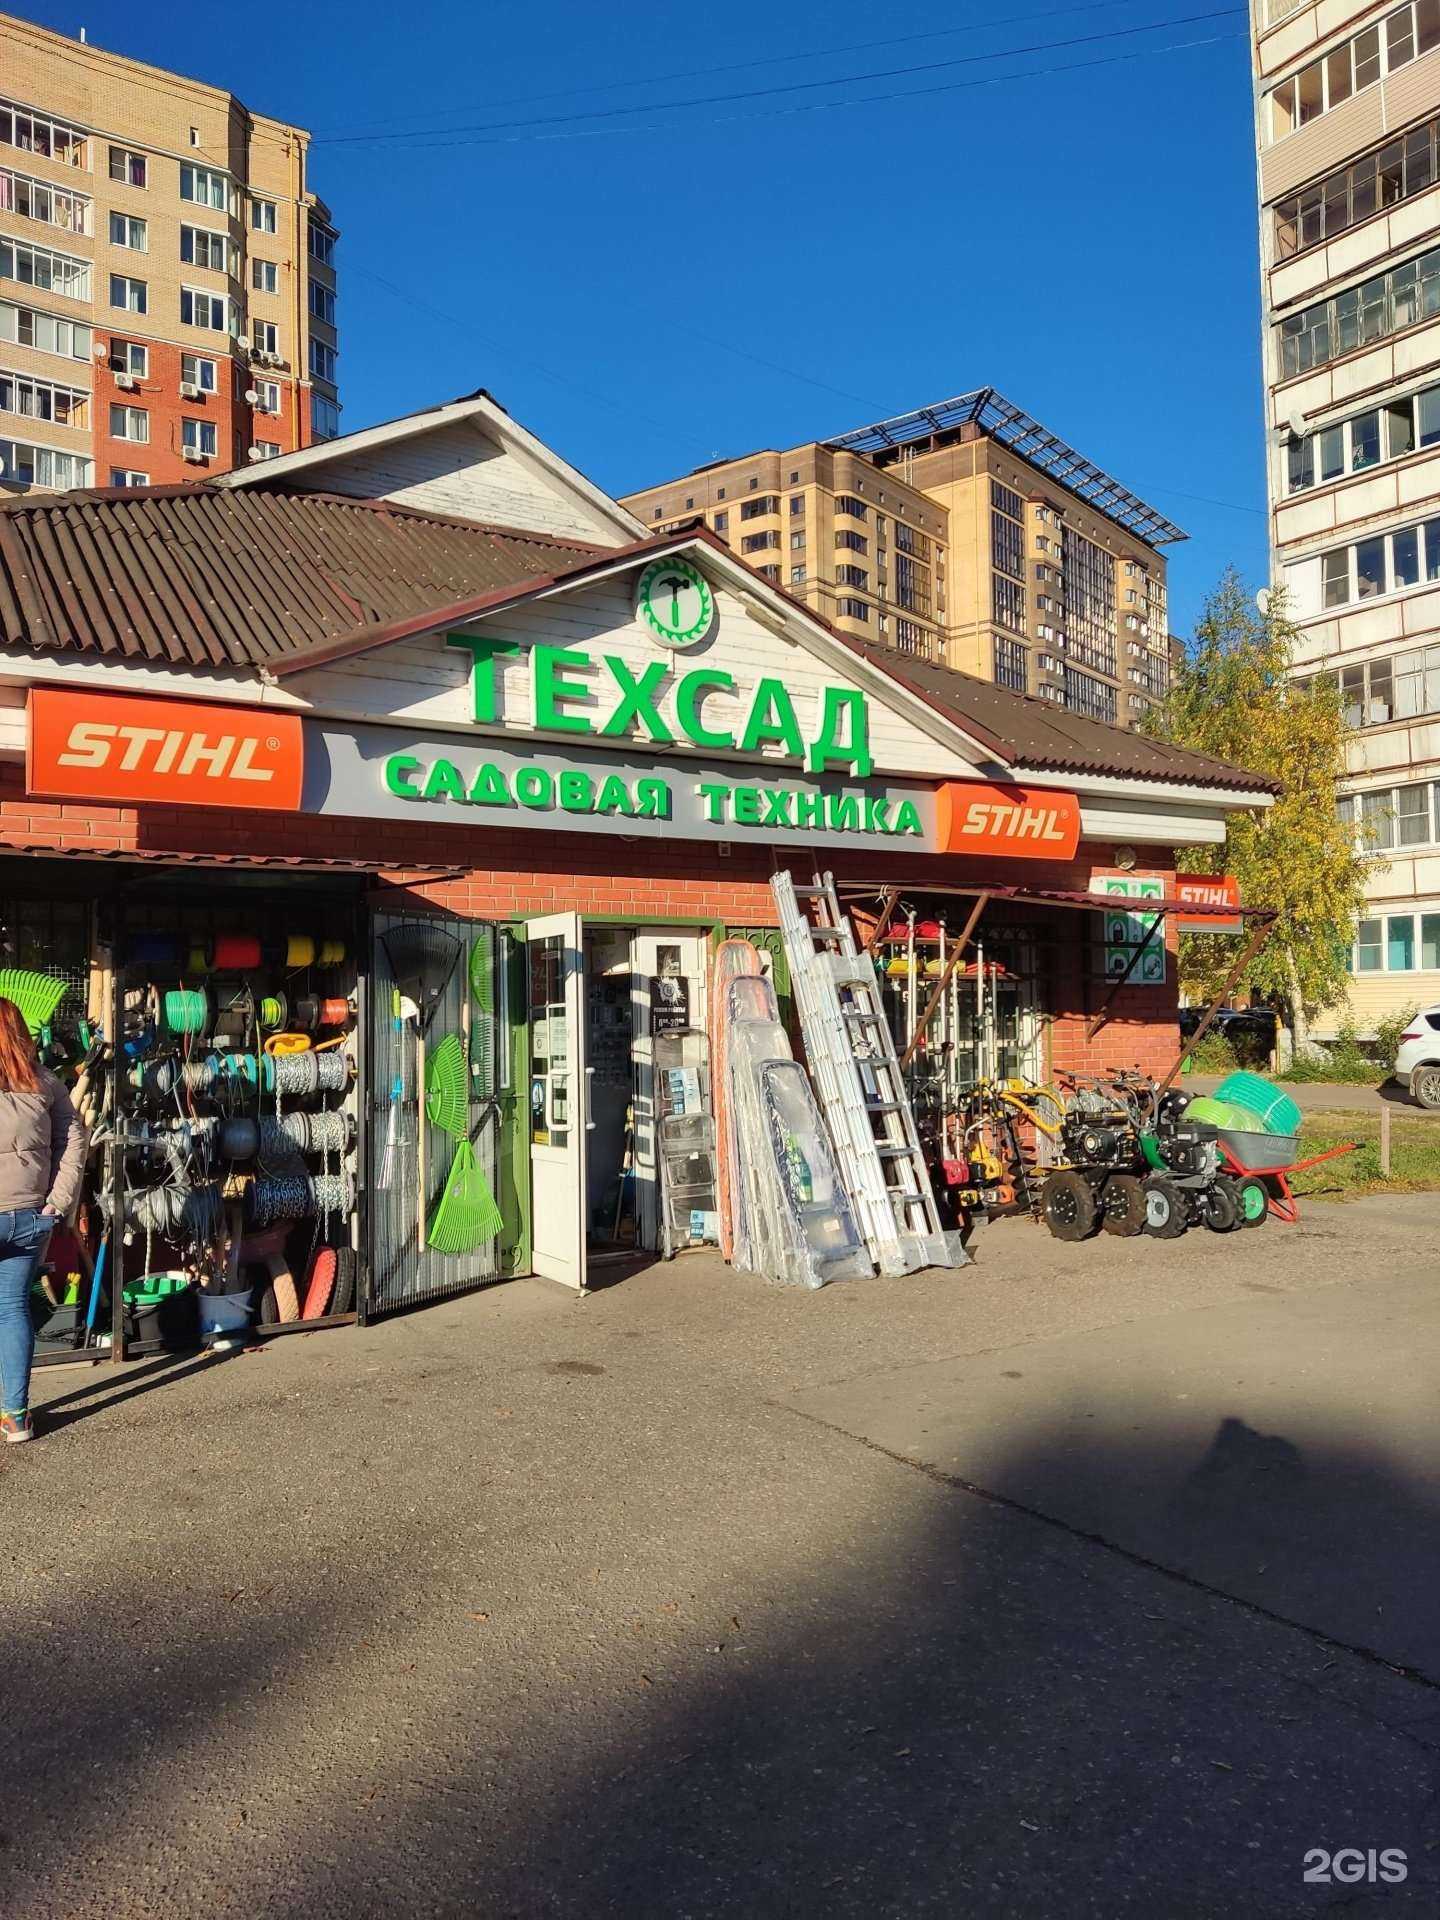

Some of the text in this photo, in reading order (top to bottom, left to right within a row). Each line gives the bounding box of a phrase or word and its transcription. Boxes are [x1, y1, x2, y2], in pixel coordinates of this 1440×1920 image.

[447, 633, 874, 778] ТЕХСАД
[57, 722, 275, 781] STIHL
[382, 755, 923, 836] САДОВАЯ ТЕХНИКА
[961, 803, 1065, 840] STIHL
[1180, 886, 1234, 907] STIHL
